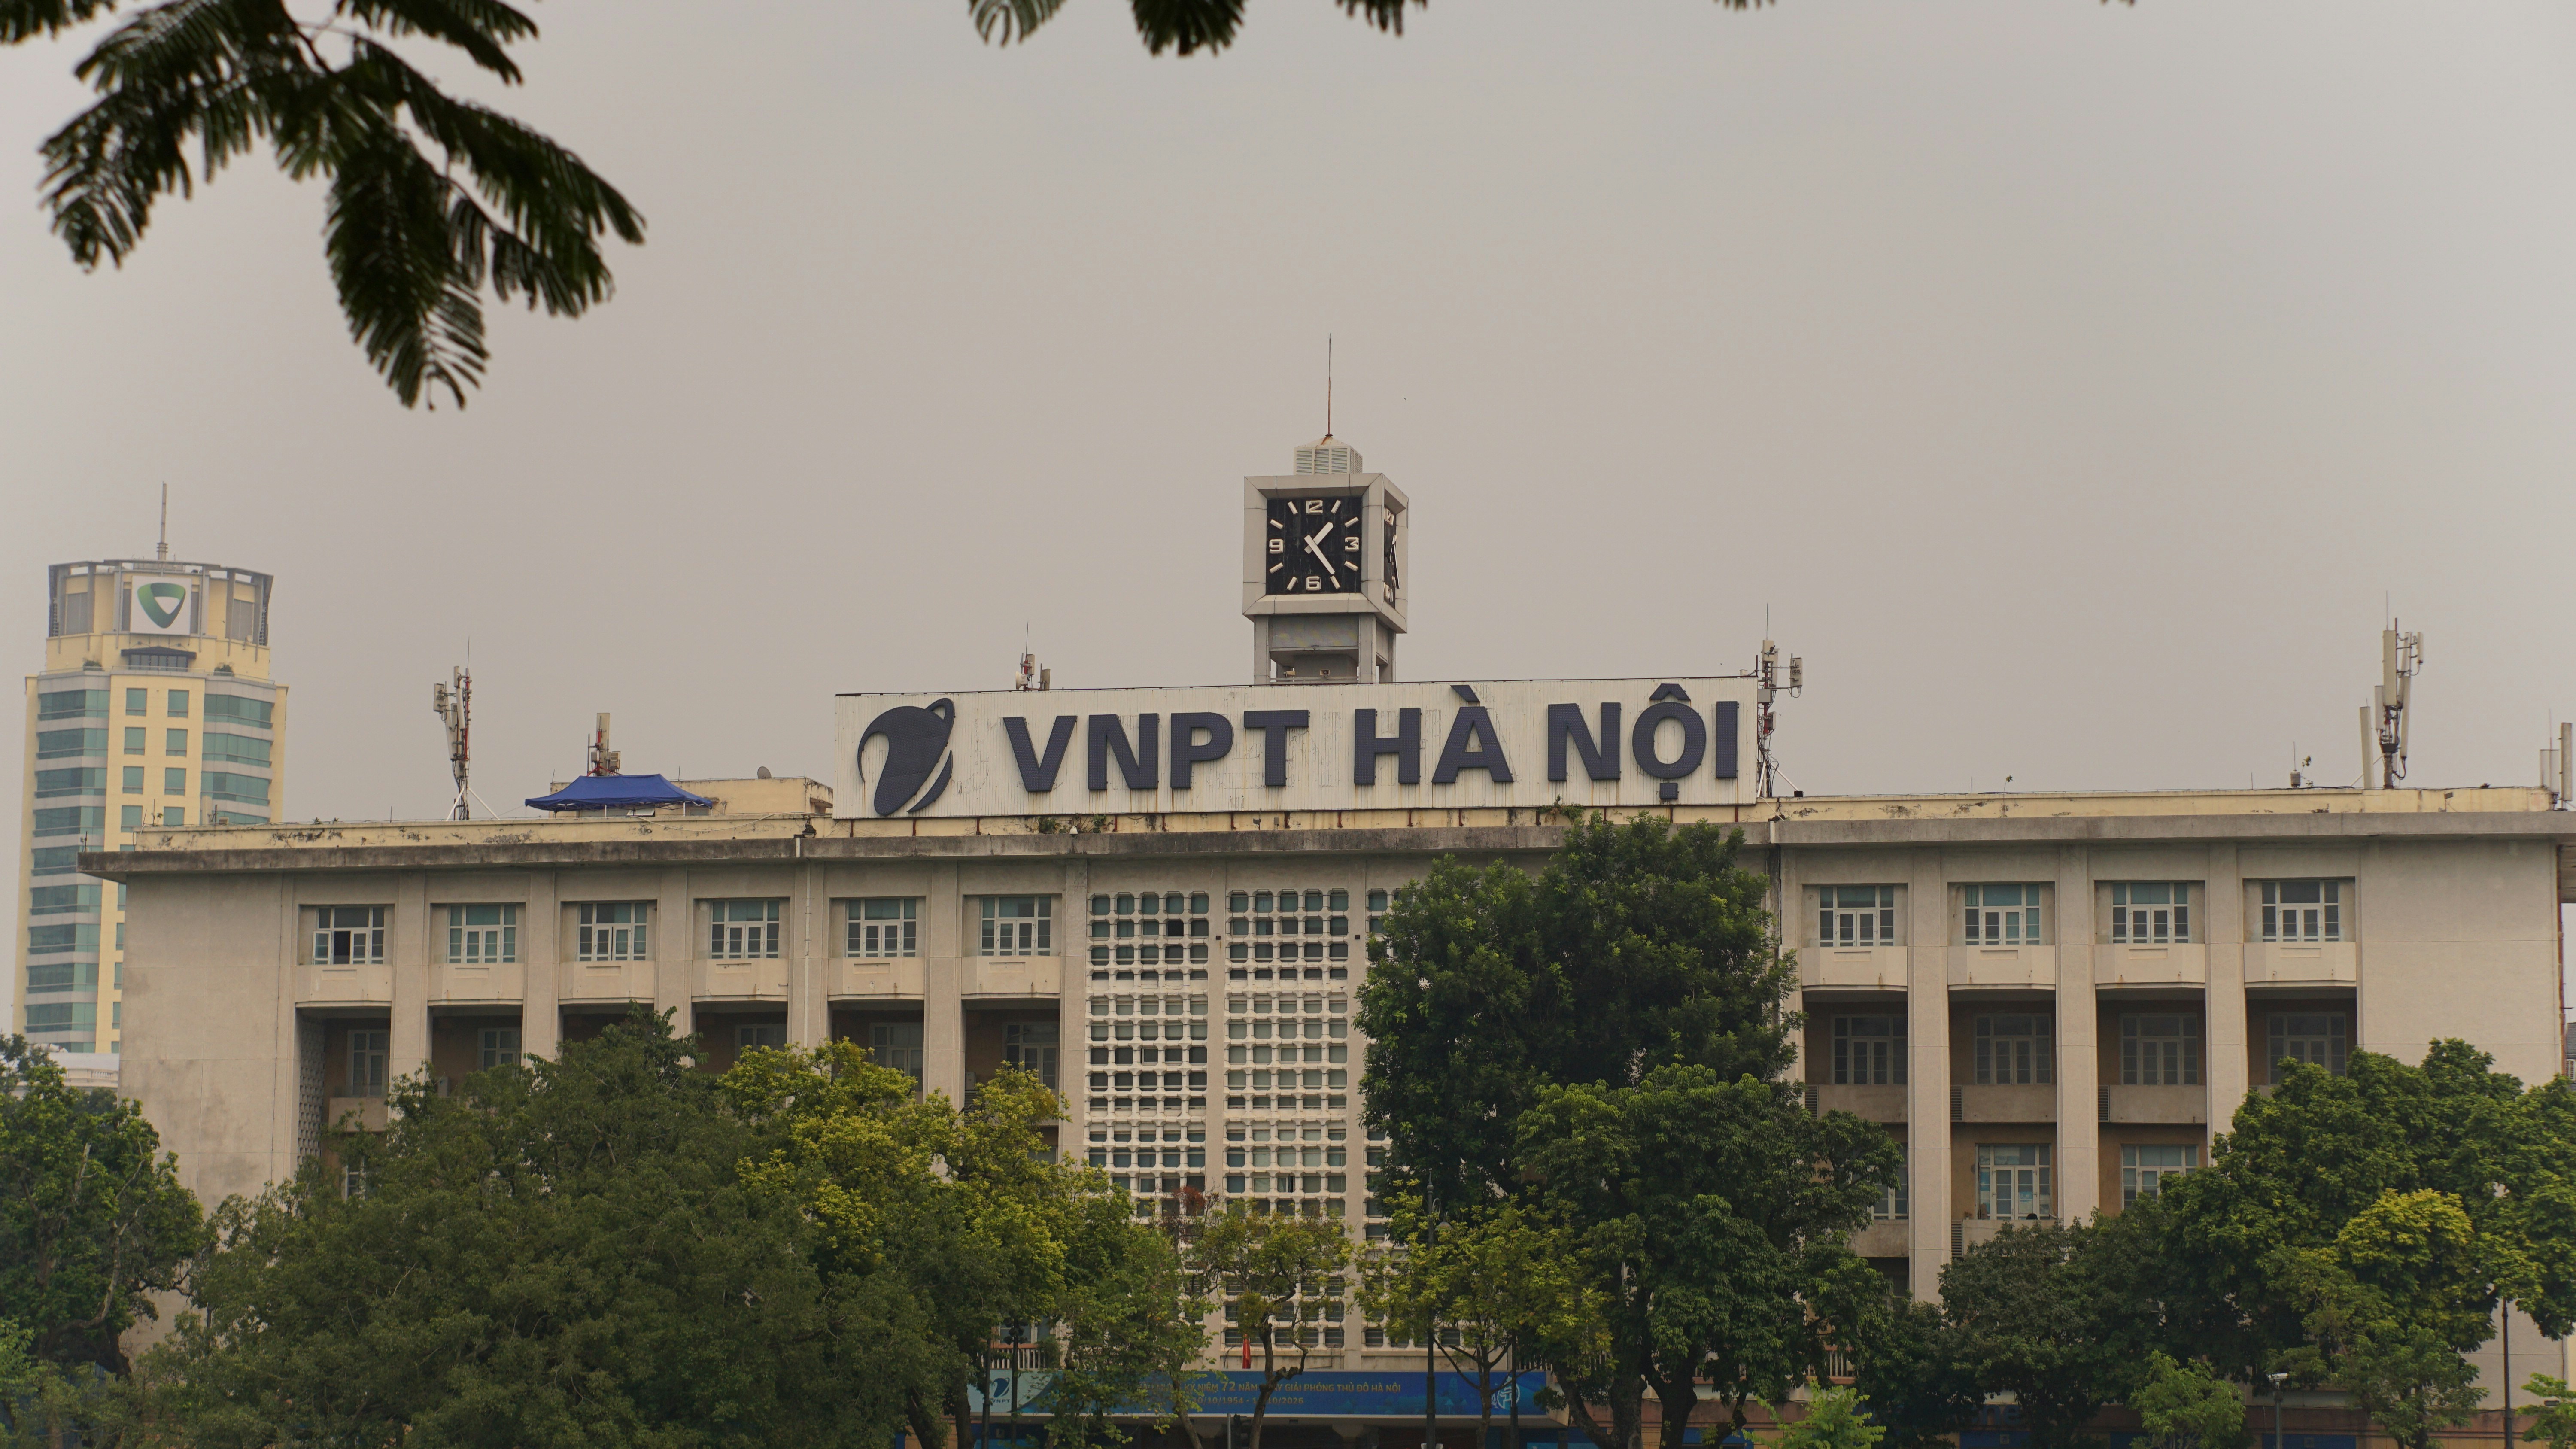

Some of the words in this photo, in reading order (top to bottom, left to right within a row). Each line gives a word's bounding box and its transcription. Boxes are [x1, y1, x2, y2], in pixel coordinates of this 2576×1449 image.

[1306, 500, 1324, 515] 12
[1269, 539, 1284, 554] 9
[1345, 537, 1359, 552] 3
[1306, 576, 1321, 591] 6
[1002, 709, 1310, 792] VNPT
[1354, 684, 1514, 784] HÀ
[1547, 683, 1739, 799] NỘI
[1221, 1381, 1236, 1391] 72
[1239, 1382, 1258, 1391] NĂM
[1285, 1382, 1302, 1391] GIẢI
[1304, 1382, 1335, 1392] PHÓNG
[1337, 1382, 1354, 1392] THỦ
[1356, 1382, 1369, 1392] ĐÔ
[1371, 1382, 1383, 1392] HÀ
[1386, 1382, 1401, 1393] NỘI
[1193, 1397, 1244, 1405] 10/10/1954
[1252, 1397, 1304, 1406] 110/2026
